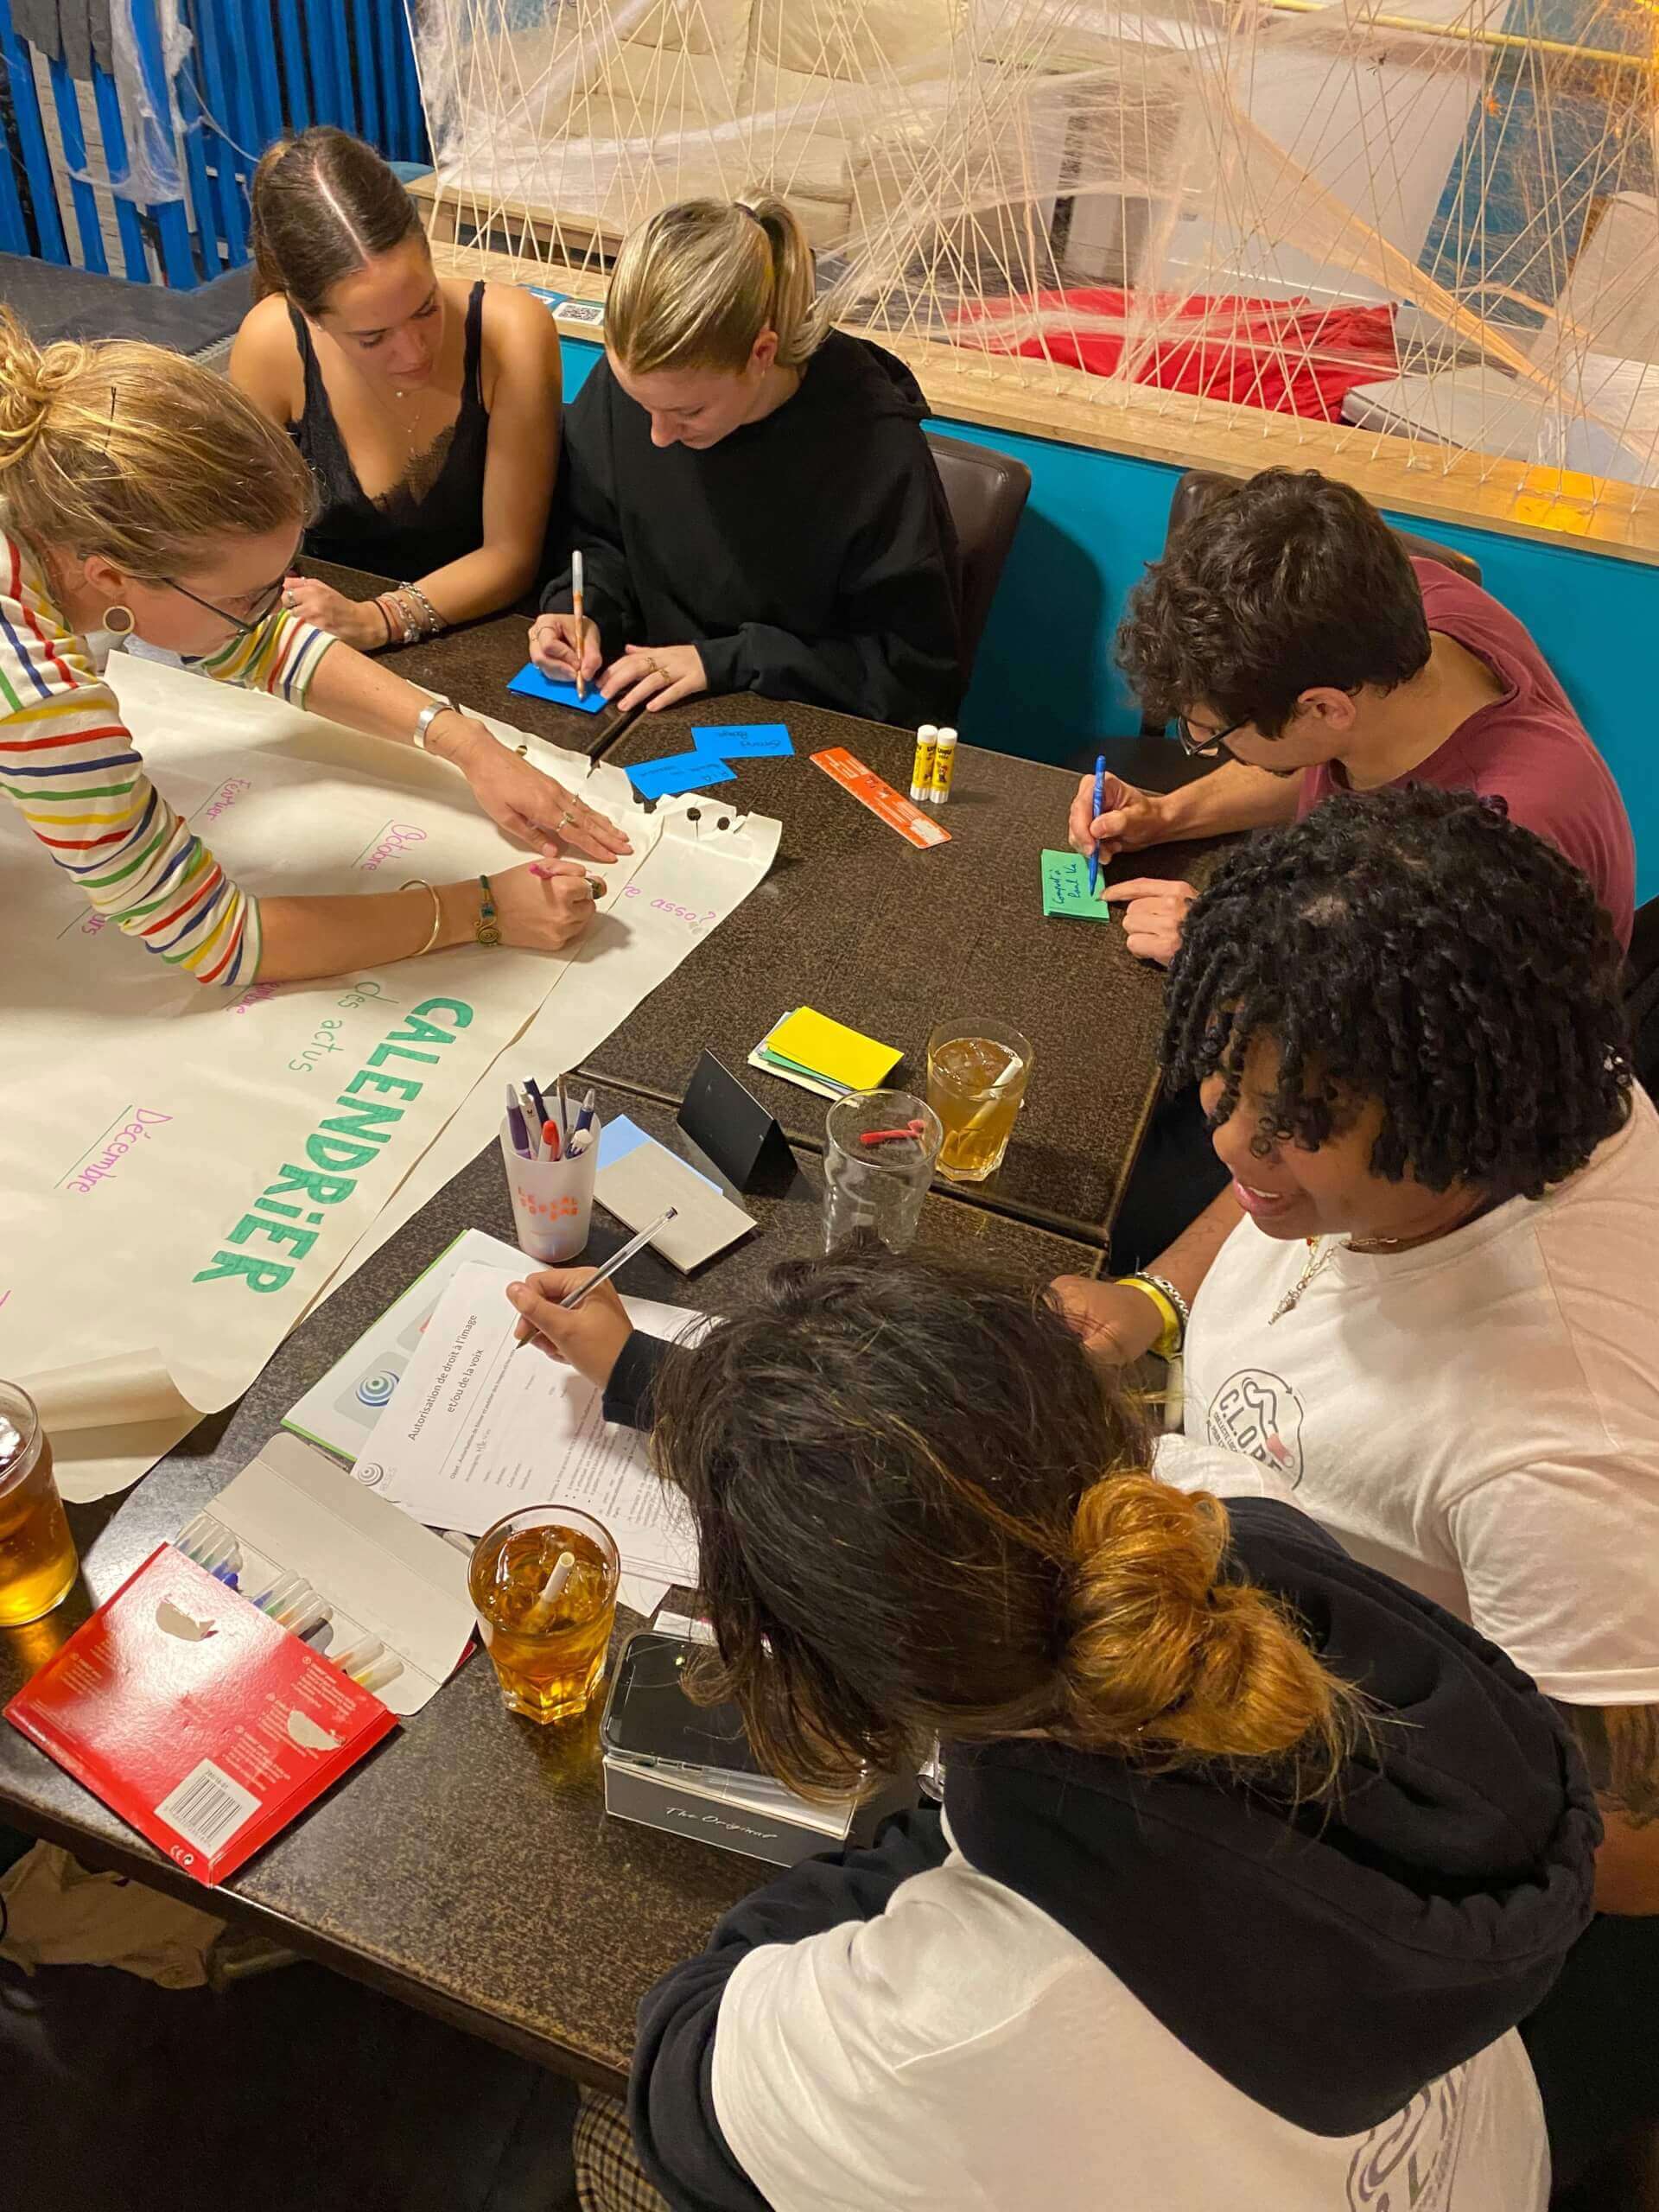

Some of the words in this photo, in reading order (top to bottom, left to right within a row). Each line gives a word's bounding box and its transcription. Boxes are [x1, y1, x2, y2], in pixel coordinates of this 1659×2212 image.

[360, 823, 427, 871] Octobre
[650, 899, 716, 924] asso?
[337, 982, 399, 1009] des
[288, 1020, 343, 1072] actus
[66, 1108, 174, 1192] Décembre
[437, 1373, 448, 1384] de
[442, 1351, 458, 1373] droit
[448, 1389, 463, 1413] et/ou
[458, 1376, 470, 1389] de
[464, 1366, 474, 1376] la
[469, 1349, 485, 1367] voix
[408, 1384, 442, 1440] Autorisation
[665, 1806, 698, 1820] The
